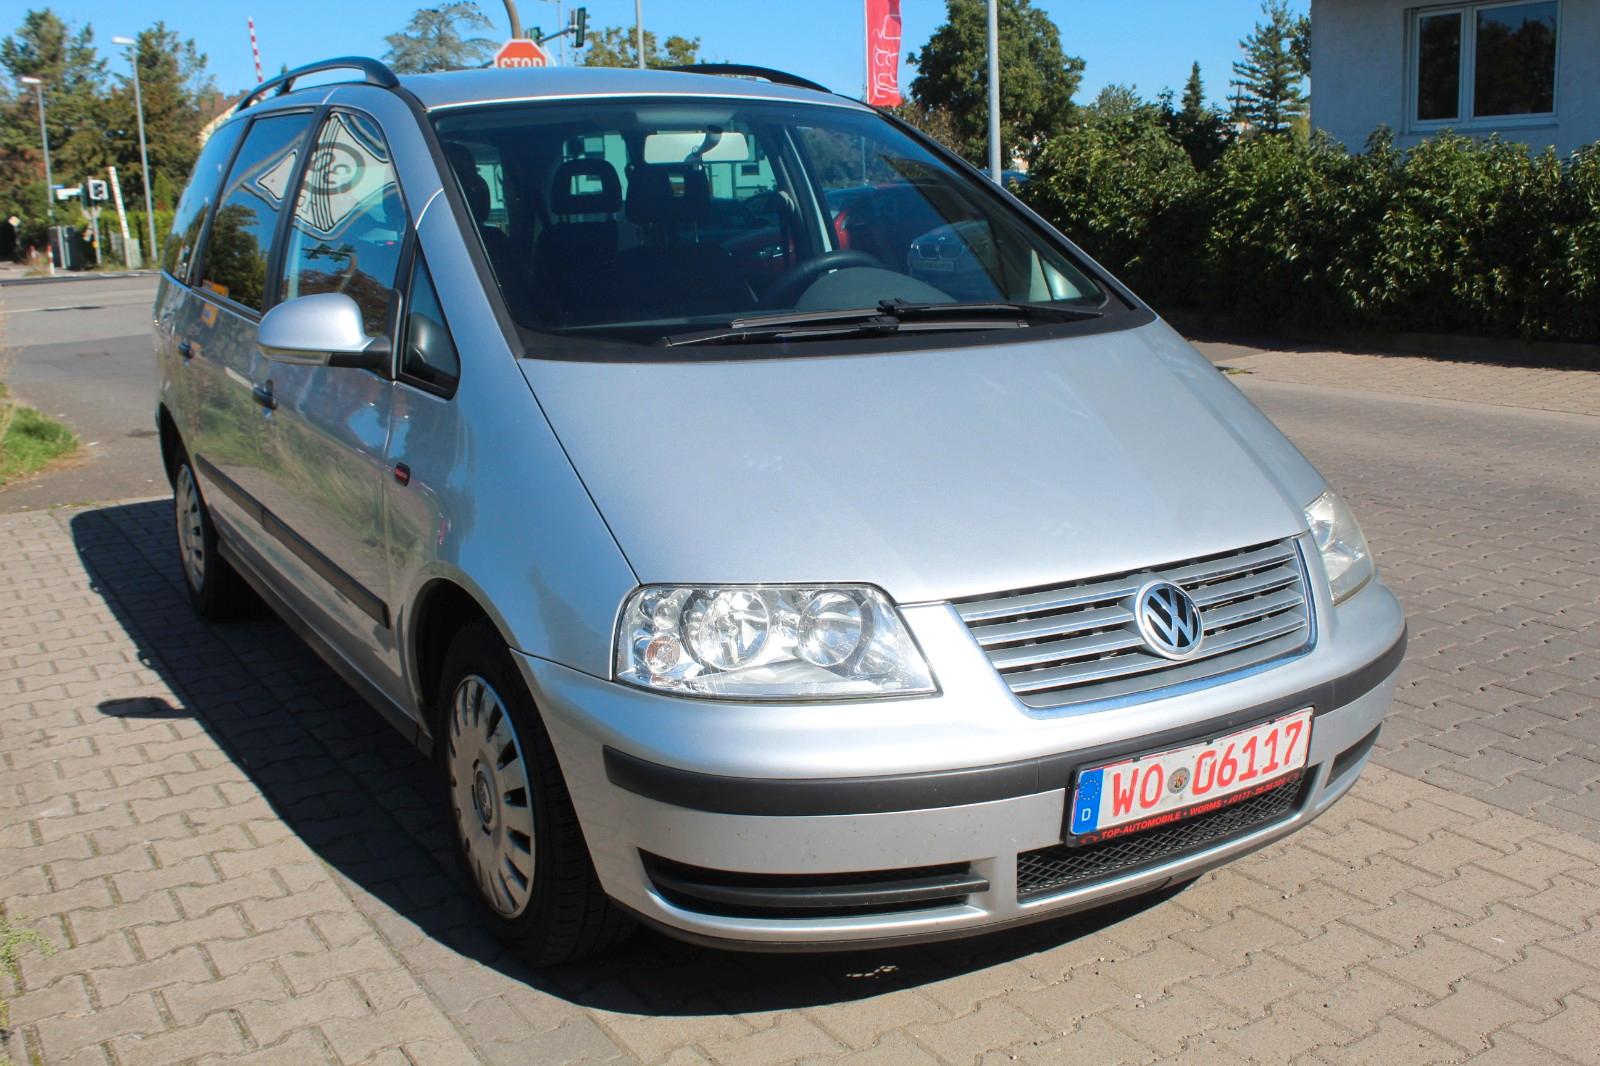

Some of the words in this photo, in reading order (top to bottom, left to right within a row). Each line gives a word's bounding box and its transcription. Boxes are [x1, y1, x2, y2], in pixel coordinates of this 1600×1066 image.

[1112, 763, 1165, 817] WO
[1192, 719, 1304, 796] 06117
[1081, 807, 1091, 821] D
[1101, 811, 1182, 839] TOP-AUTOMOBILE
[1190, 799, 1222, 816] WORMS
